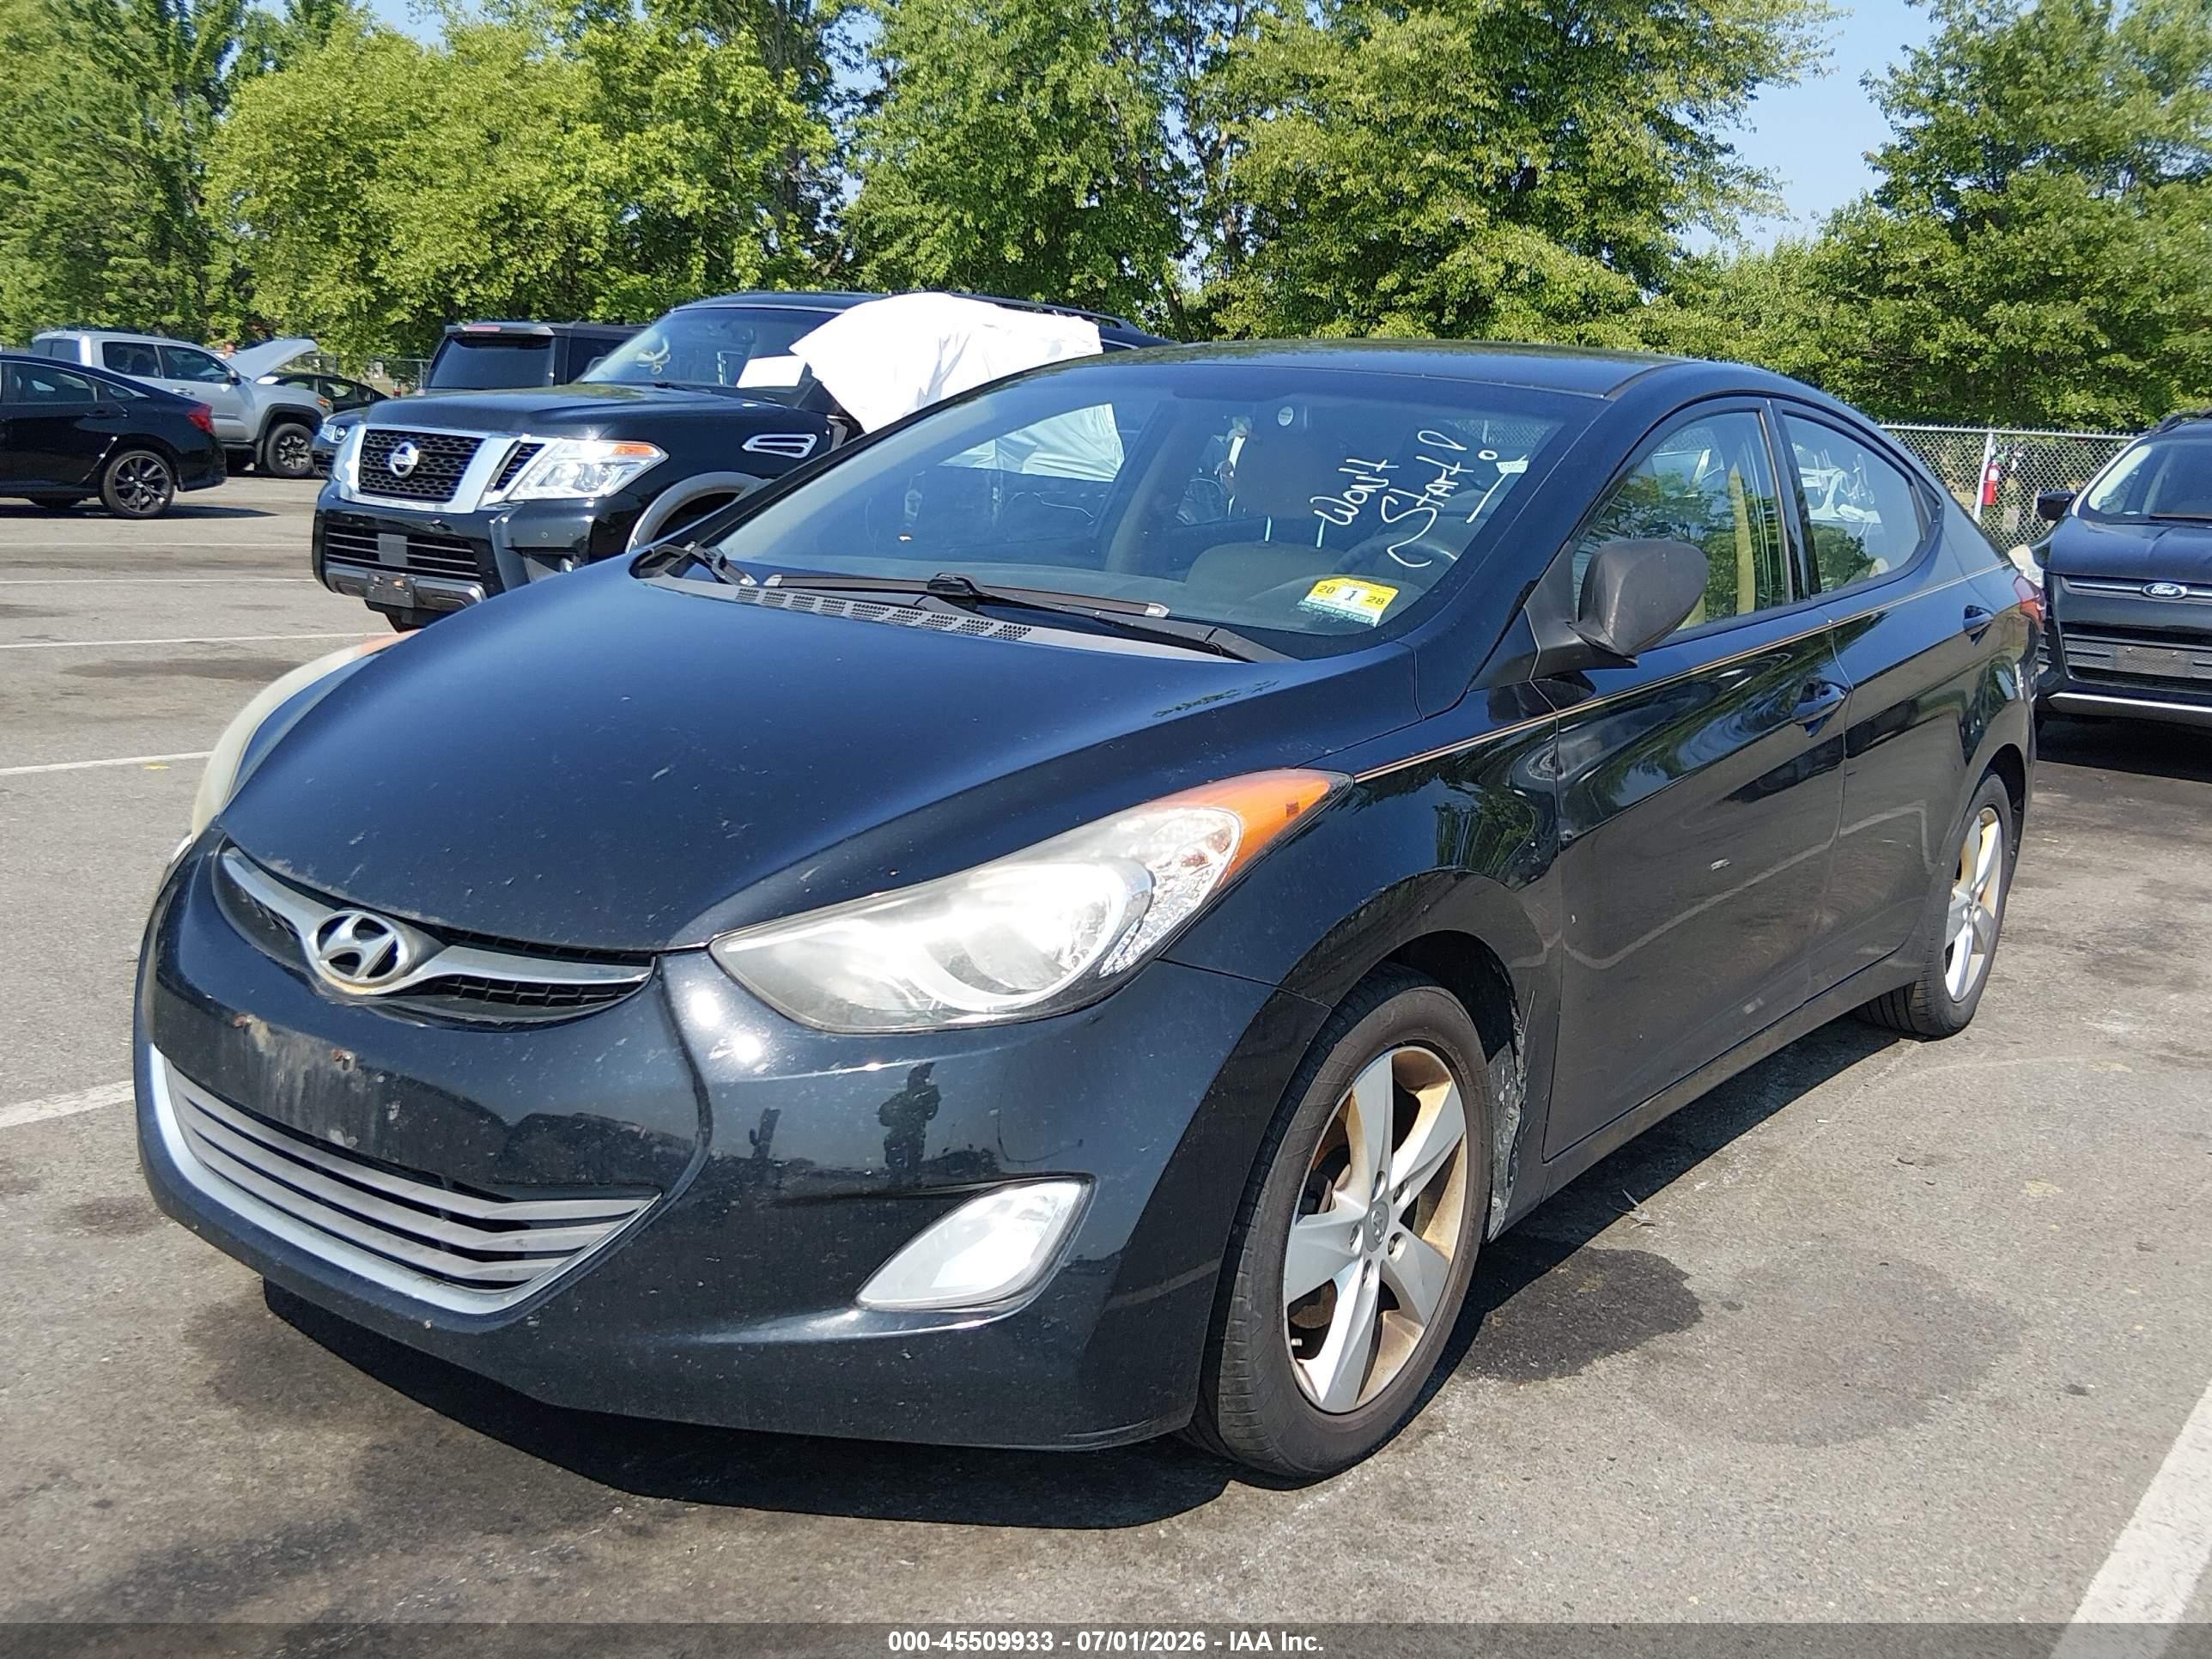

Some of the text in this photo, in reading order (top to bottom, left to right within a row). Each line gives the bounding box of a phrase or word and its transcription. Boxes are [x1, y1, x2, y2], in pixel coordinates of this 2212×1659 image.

[1317, 585, 1336, 595] 20
[1365, 595, 1385, 605] 28
[2151, 584, 2178, 595] Ford
